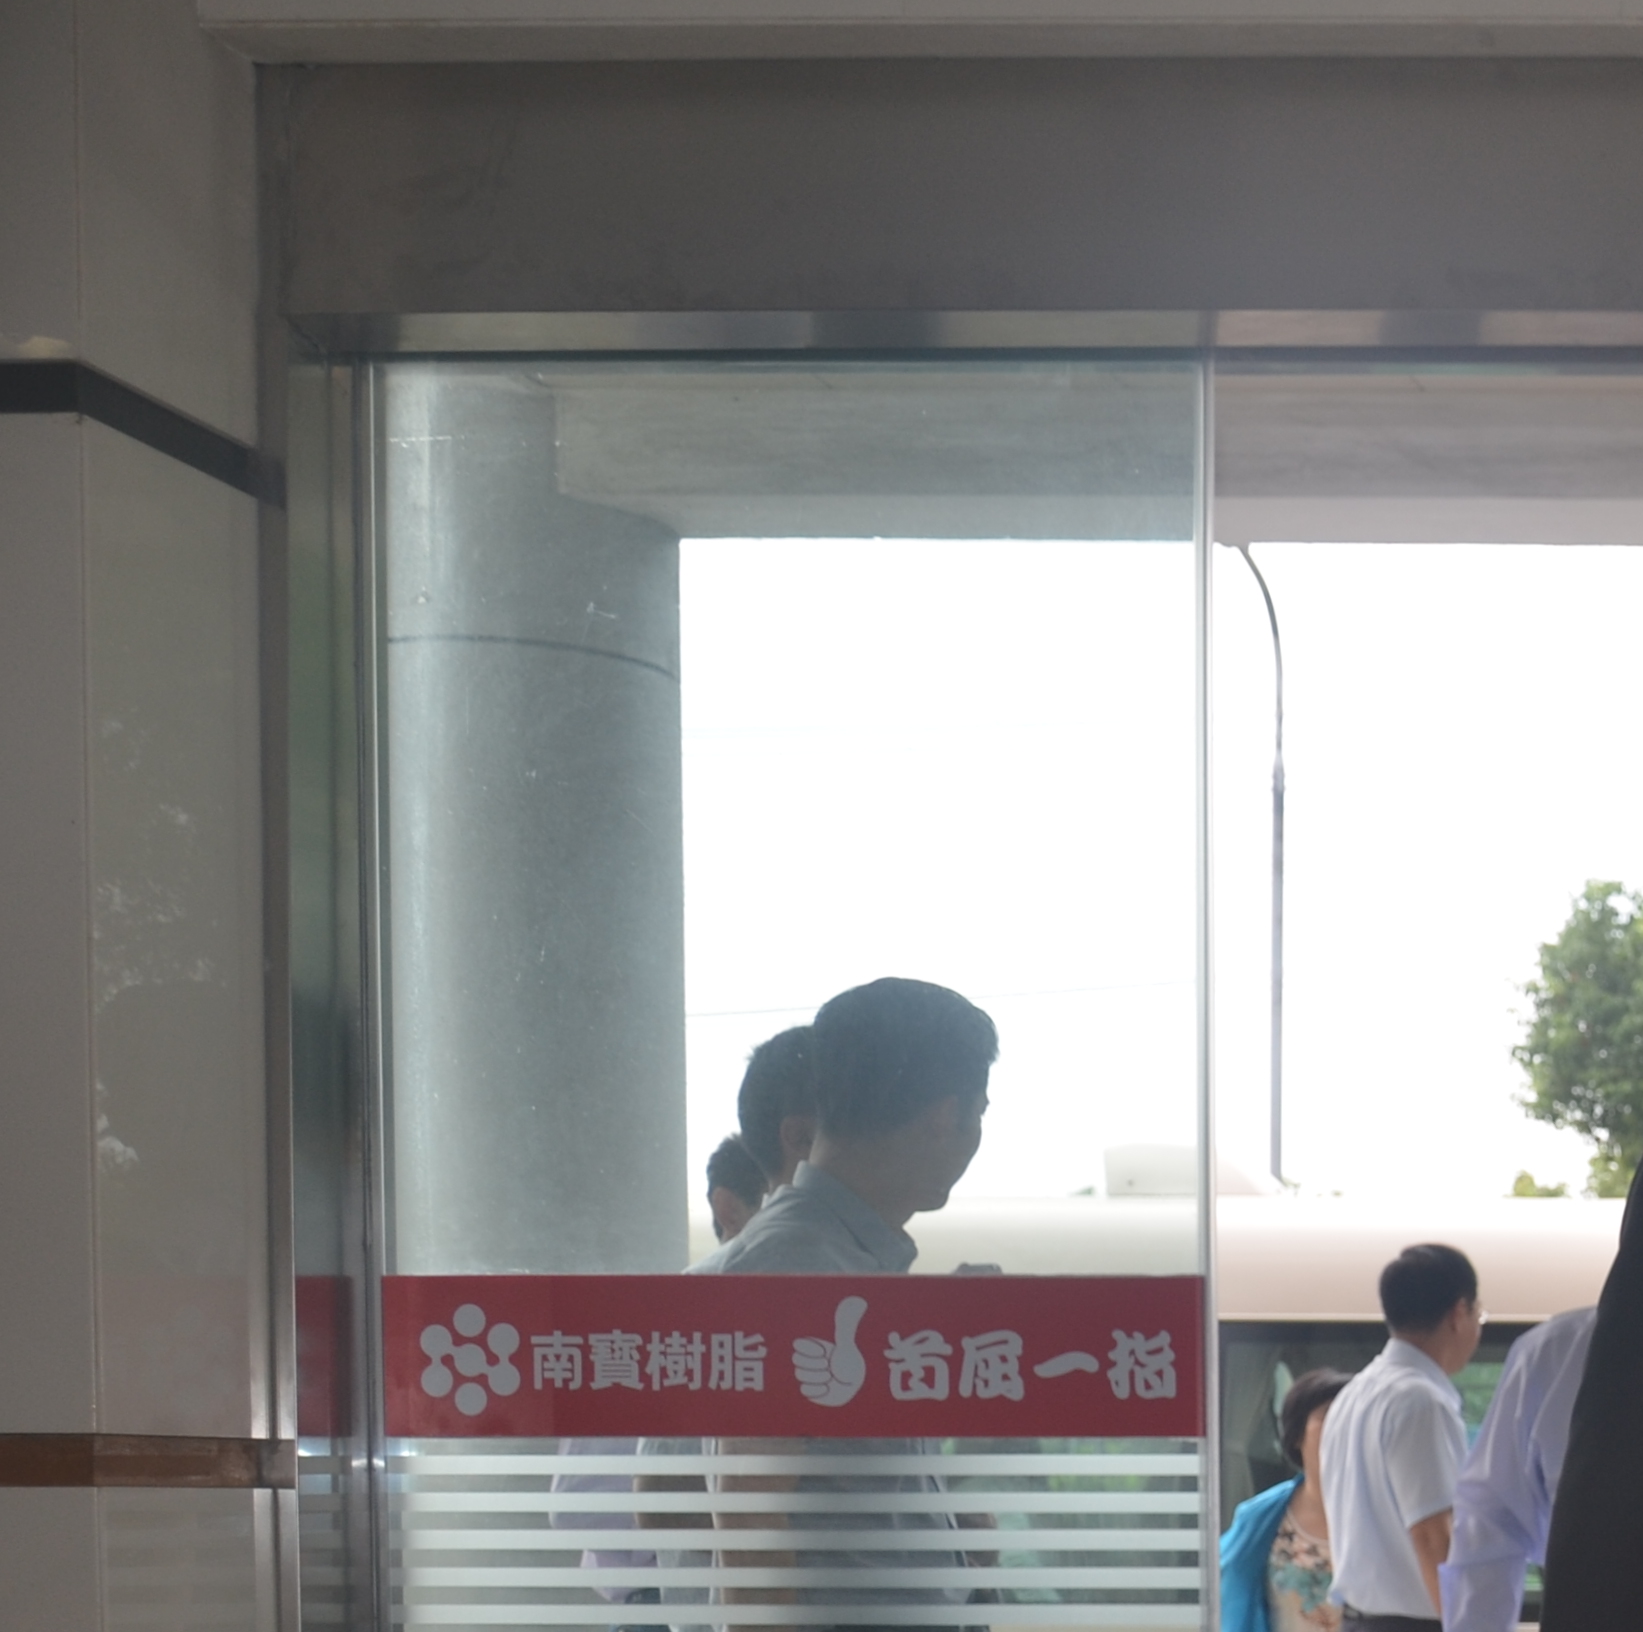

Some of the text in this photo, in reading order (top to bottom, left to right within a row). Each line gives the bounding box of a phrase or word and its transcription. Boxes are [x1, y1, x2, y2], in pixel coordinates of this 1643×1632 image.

[530, 1329, 1177, 1401] 南寶樹脂 首屈一指
